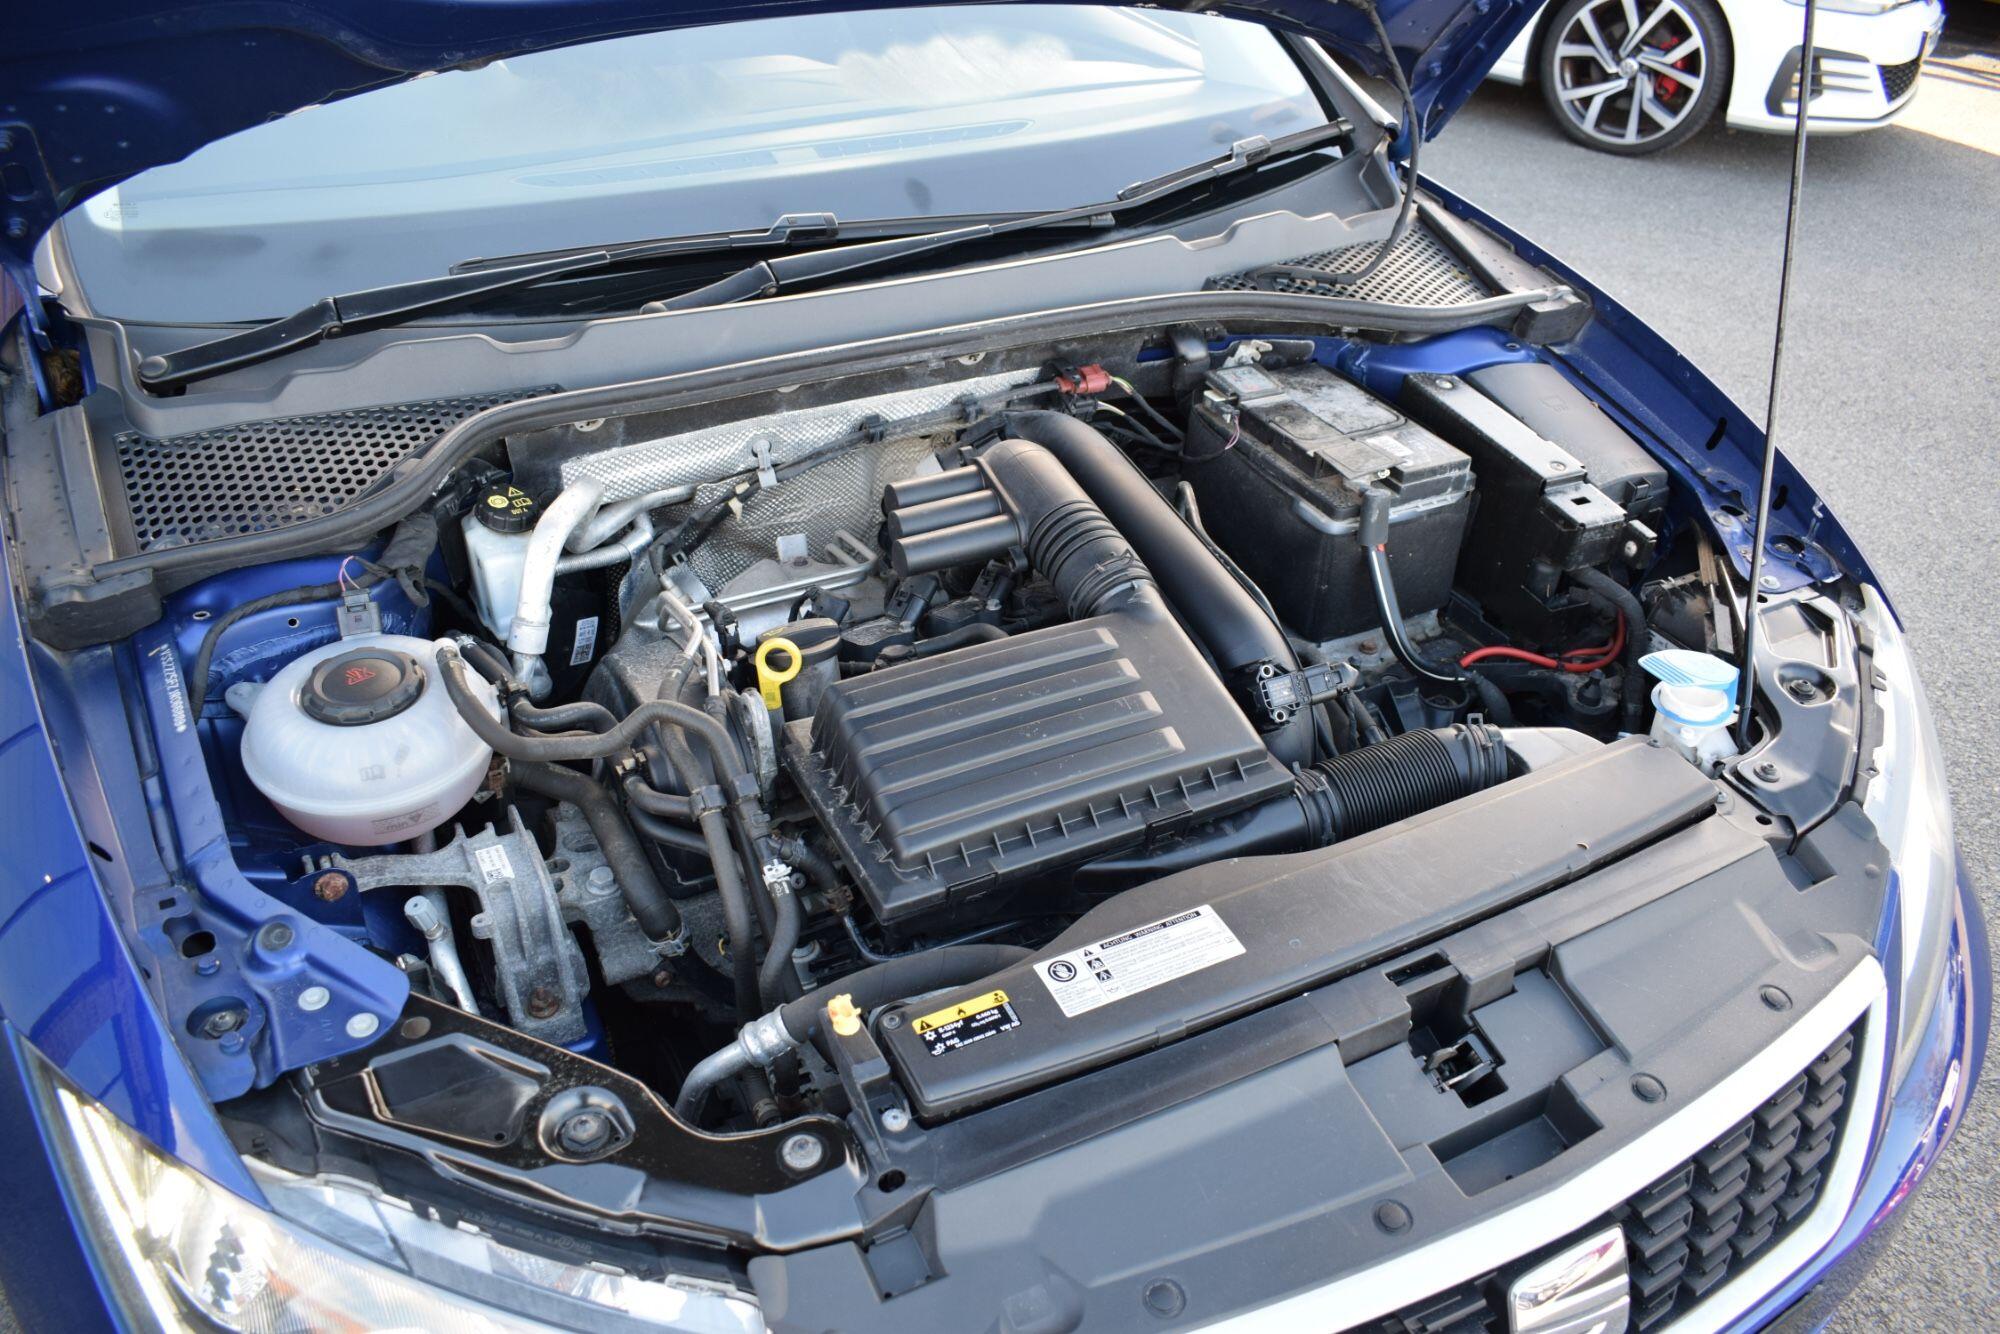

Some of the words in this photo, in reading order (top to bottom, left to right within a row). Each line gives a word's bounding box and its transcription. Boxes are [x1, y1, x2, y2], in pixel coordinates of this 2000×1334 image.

[1102, 935, 1132, 949] ACHTUNG
[1135, 923, 1164, 938] WARNING
[1166, 912, 1197, 927] ATTENTION
